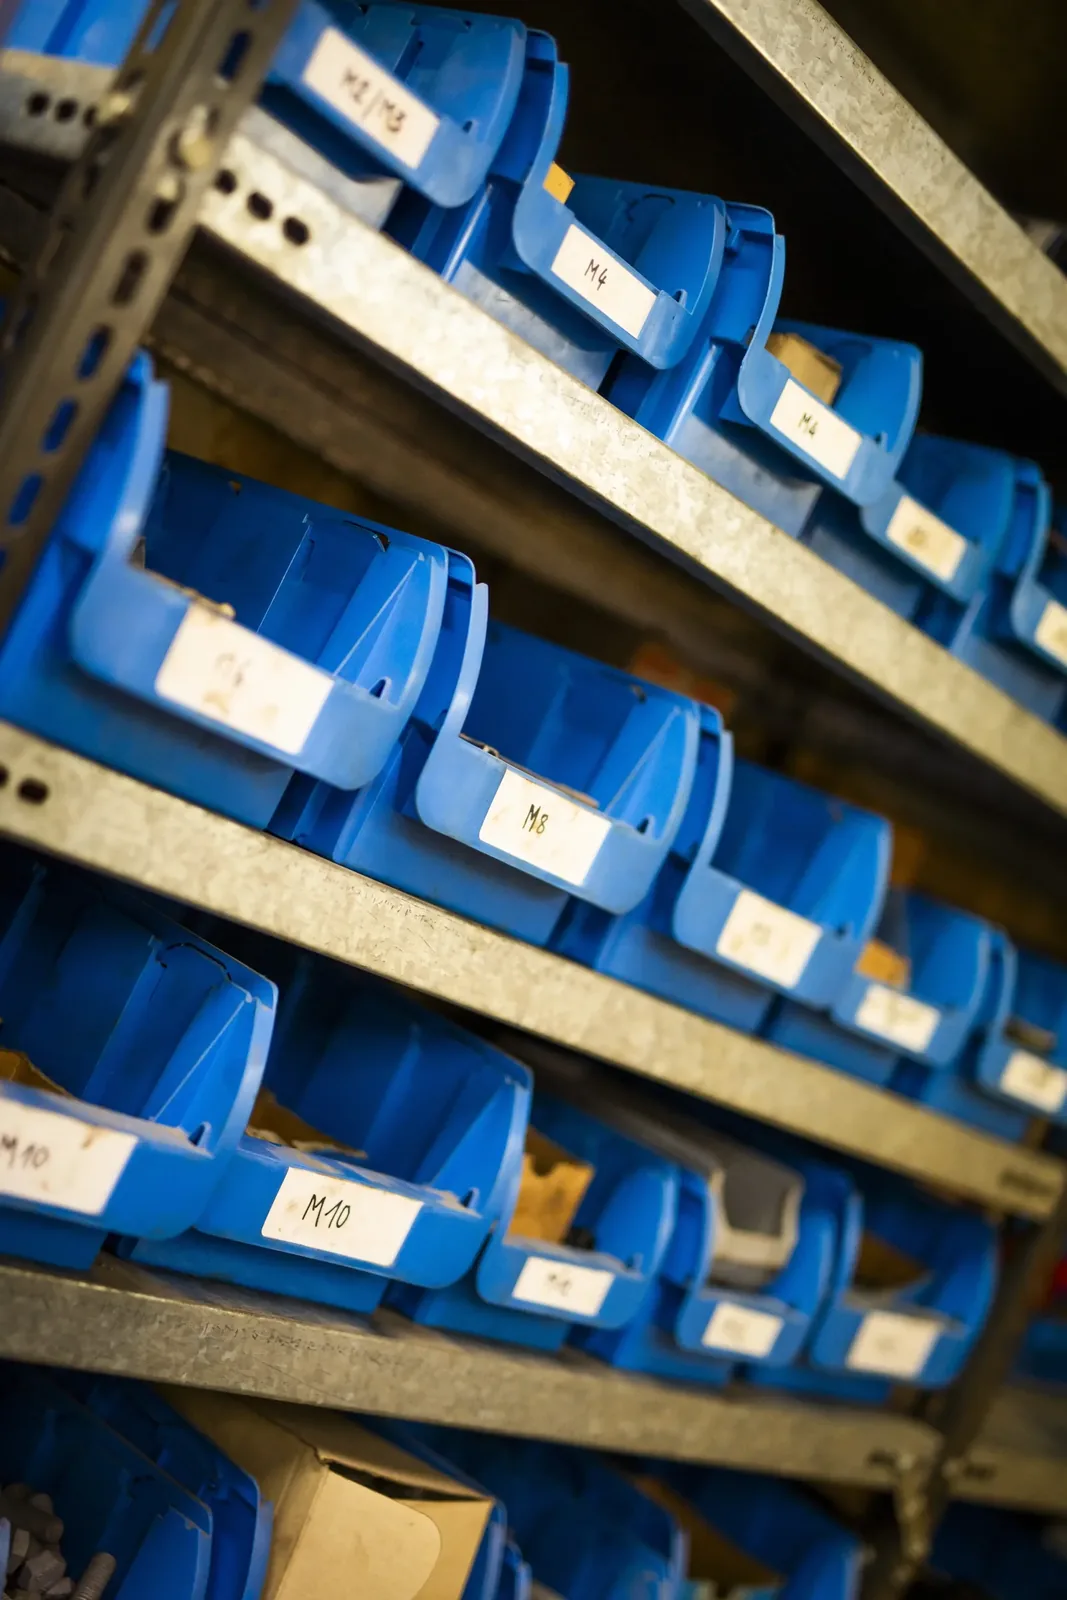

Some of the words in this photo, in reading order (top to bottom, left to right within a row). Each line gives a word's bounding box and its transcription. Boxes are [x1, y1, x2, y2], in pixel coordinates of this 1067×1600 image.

[584, 258, 608, 291] M4
[522, 804, 549, 834] M8
[0, 1134, 49, 1169] M10
[302, 1193, 351, 1229] M10
